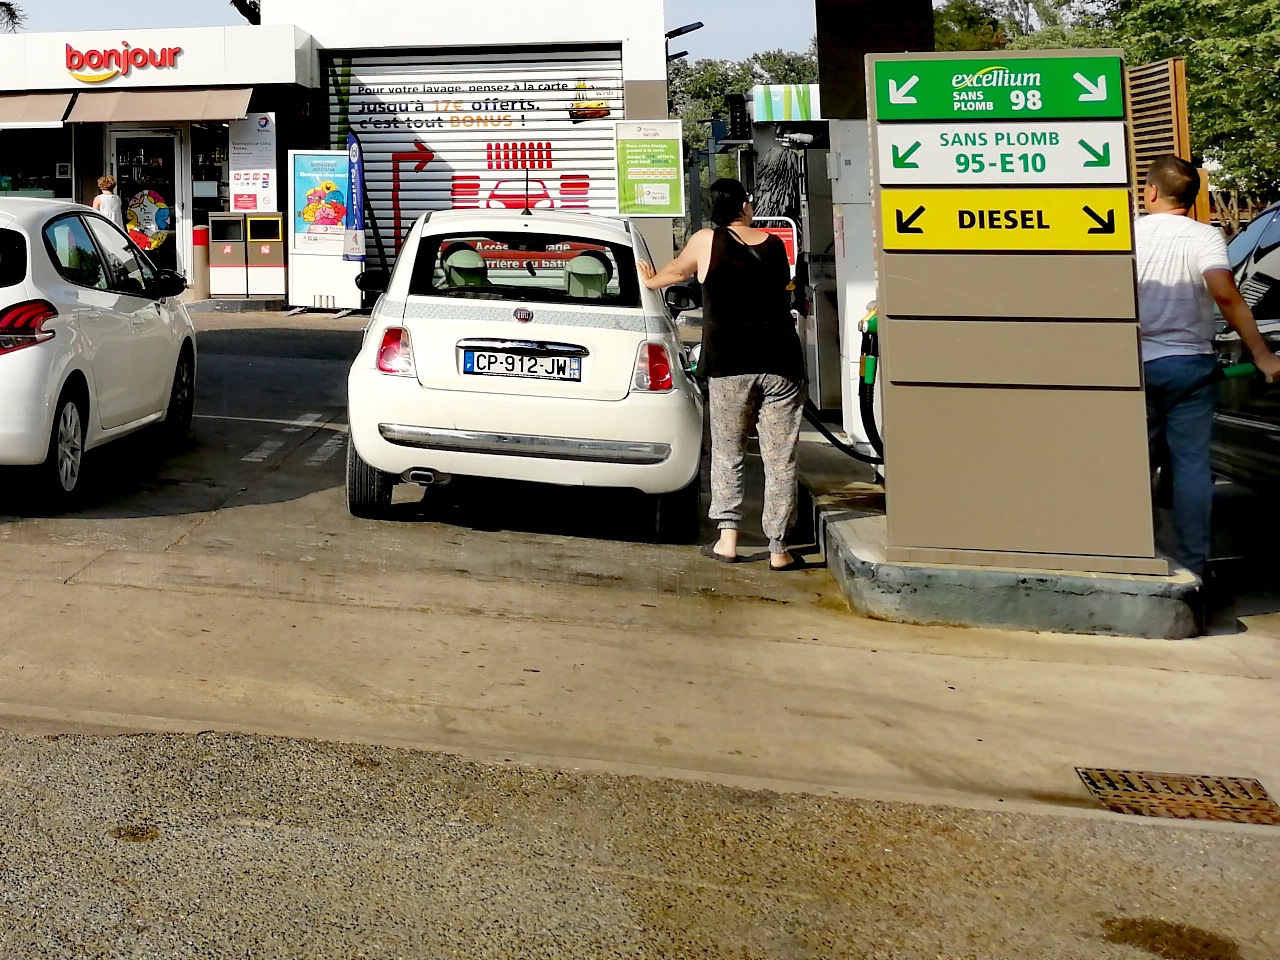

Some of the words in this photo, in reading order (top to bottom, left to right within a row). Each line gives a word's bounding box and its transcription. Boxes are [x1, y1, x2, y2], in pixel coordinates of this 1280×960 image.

[65, 41, 182, 76] bonjour
[951, 68, 1041, 89] excellium
[358, 86, 384, 94] Pour
[388, 85, 419, 94] votre
[524, 81, 534, 91] la
[538, 81, 569, 91] carte
[953, 91, 984, 101] SANS
[1009, 89, 1043, 111] 98
[471, 98, 540, 111] offerts,
[953, 101, 994, 111] PLOMB
[359, 117, 400, 129] c'est
[405, 117, 444, 129] tout
[449, 115, 513, 127] BONUS
[939, 132, 988, 147] SANS
[994, 131, 1060, 146] PLOMB
[955, 152, 1047, 174] 95-E10
[957, 209, 1051, 230] DIESEL
[486, 259, 520, 268] rrière
[476, 353, 567, 376] CP-912-JW
